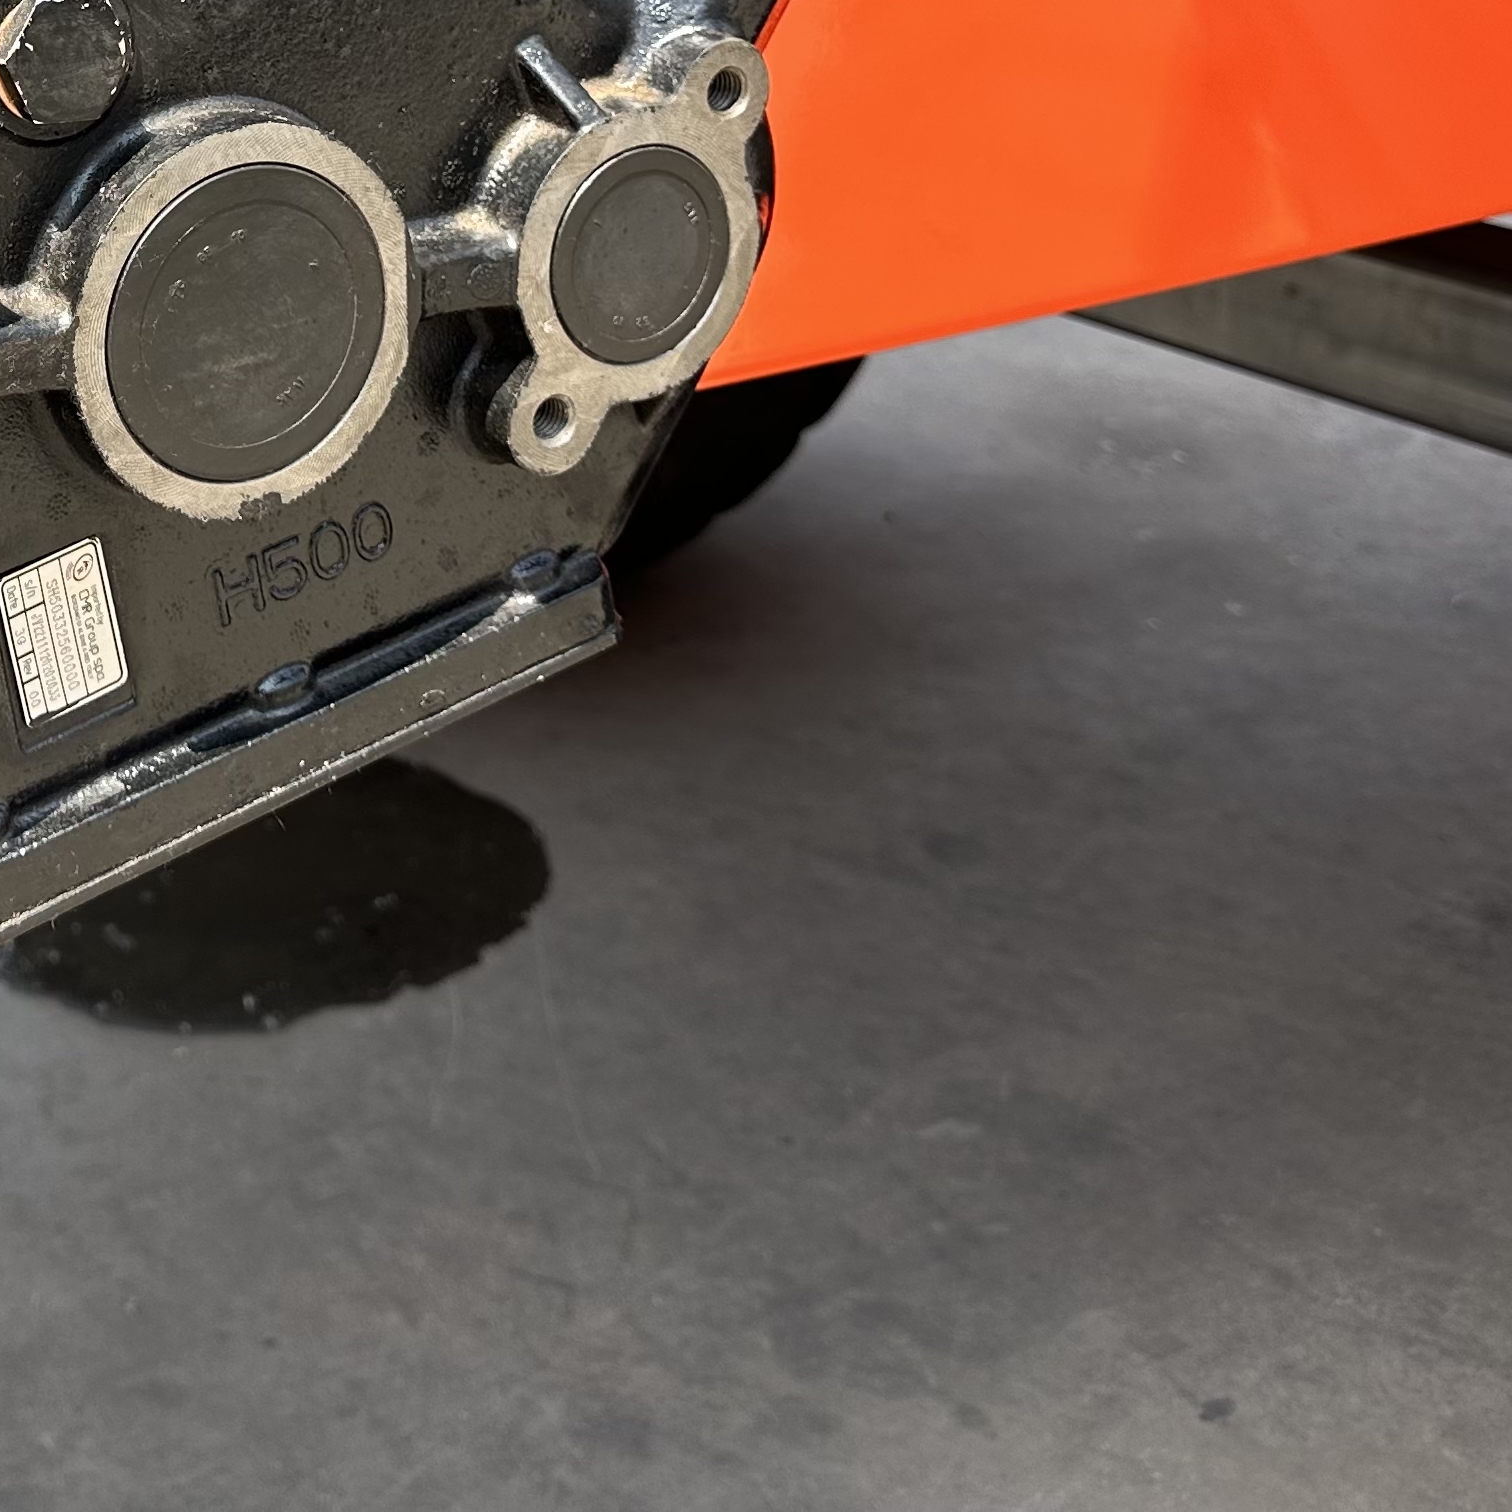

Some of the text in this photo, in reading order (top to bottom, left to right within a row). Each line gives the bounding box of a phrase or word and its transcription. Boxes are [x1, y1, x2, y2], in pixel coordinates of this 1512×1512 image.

[213, 500, 394, 628] H500
[6, 585, 18, 610] Date
[22, 657, 33, 675] Rev
[84, 617, 100, 655] Group
